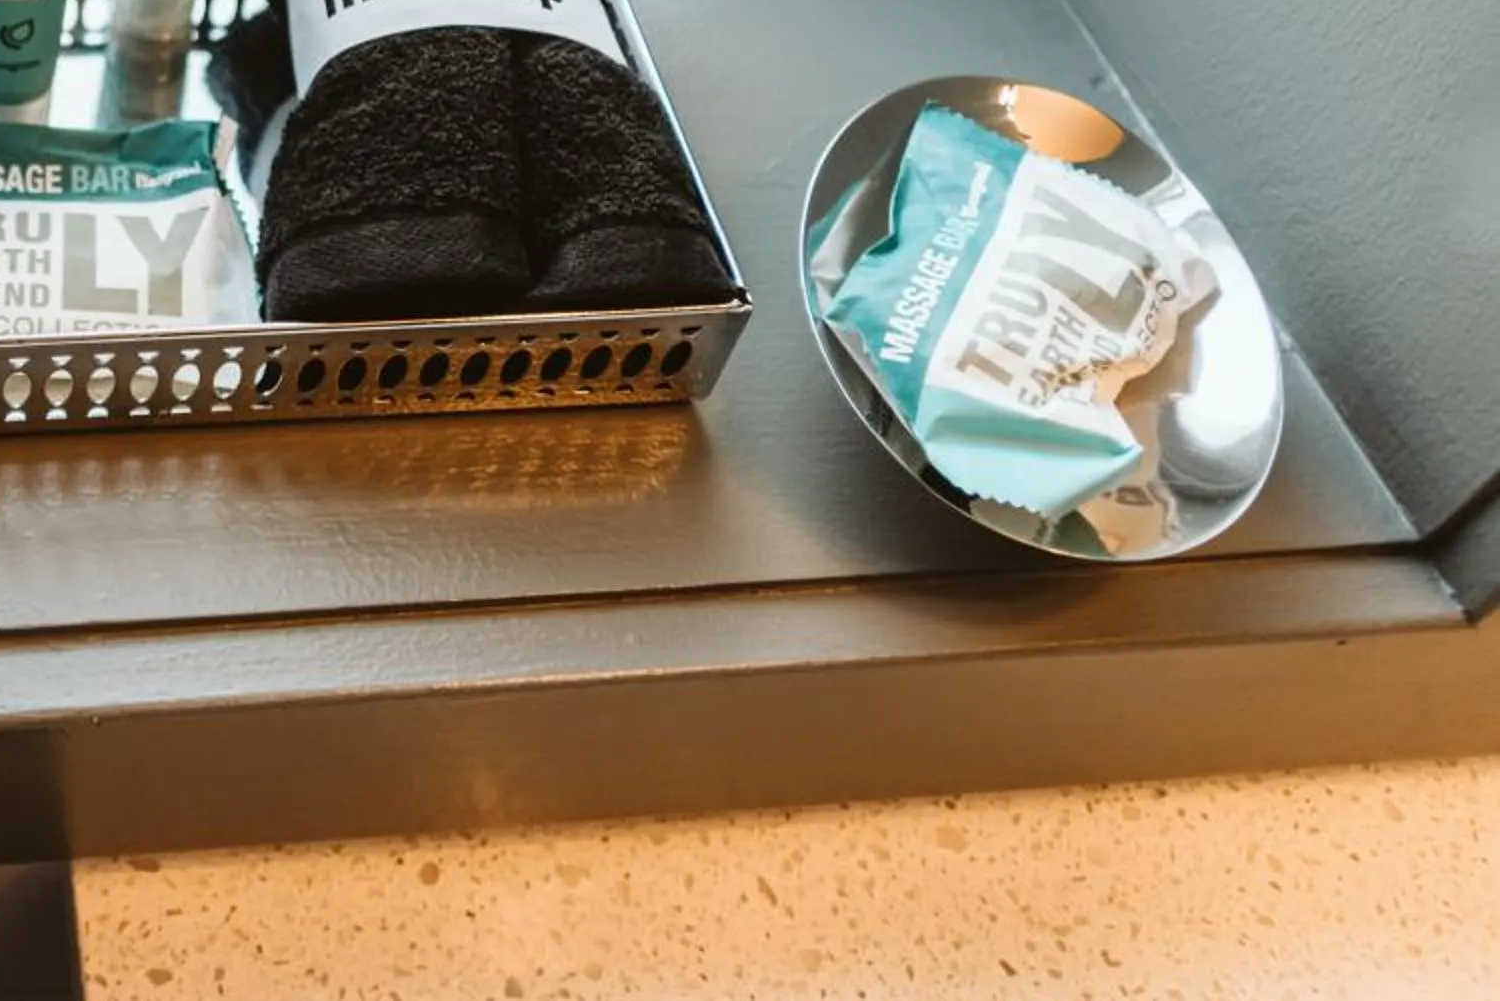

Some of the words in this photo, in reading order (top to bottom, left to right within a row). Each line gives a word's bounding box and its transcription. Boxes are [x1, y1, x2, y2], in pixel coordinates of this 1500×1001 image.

[71, 165, 130, 194] BAR
[61, 206, 211, 317] LY
[879, 248, 959, 364] MASSAGE
[931, 216, 981, 251] BAR
[1001, 183, 1161, 334] LY
[956, 274, 1049, 387] TRU
